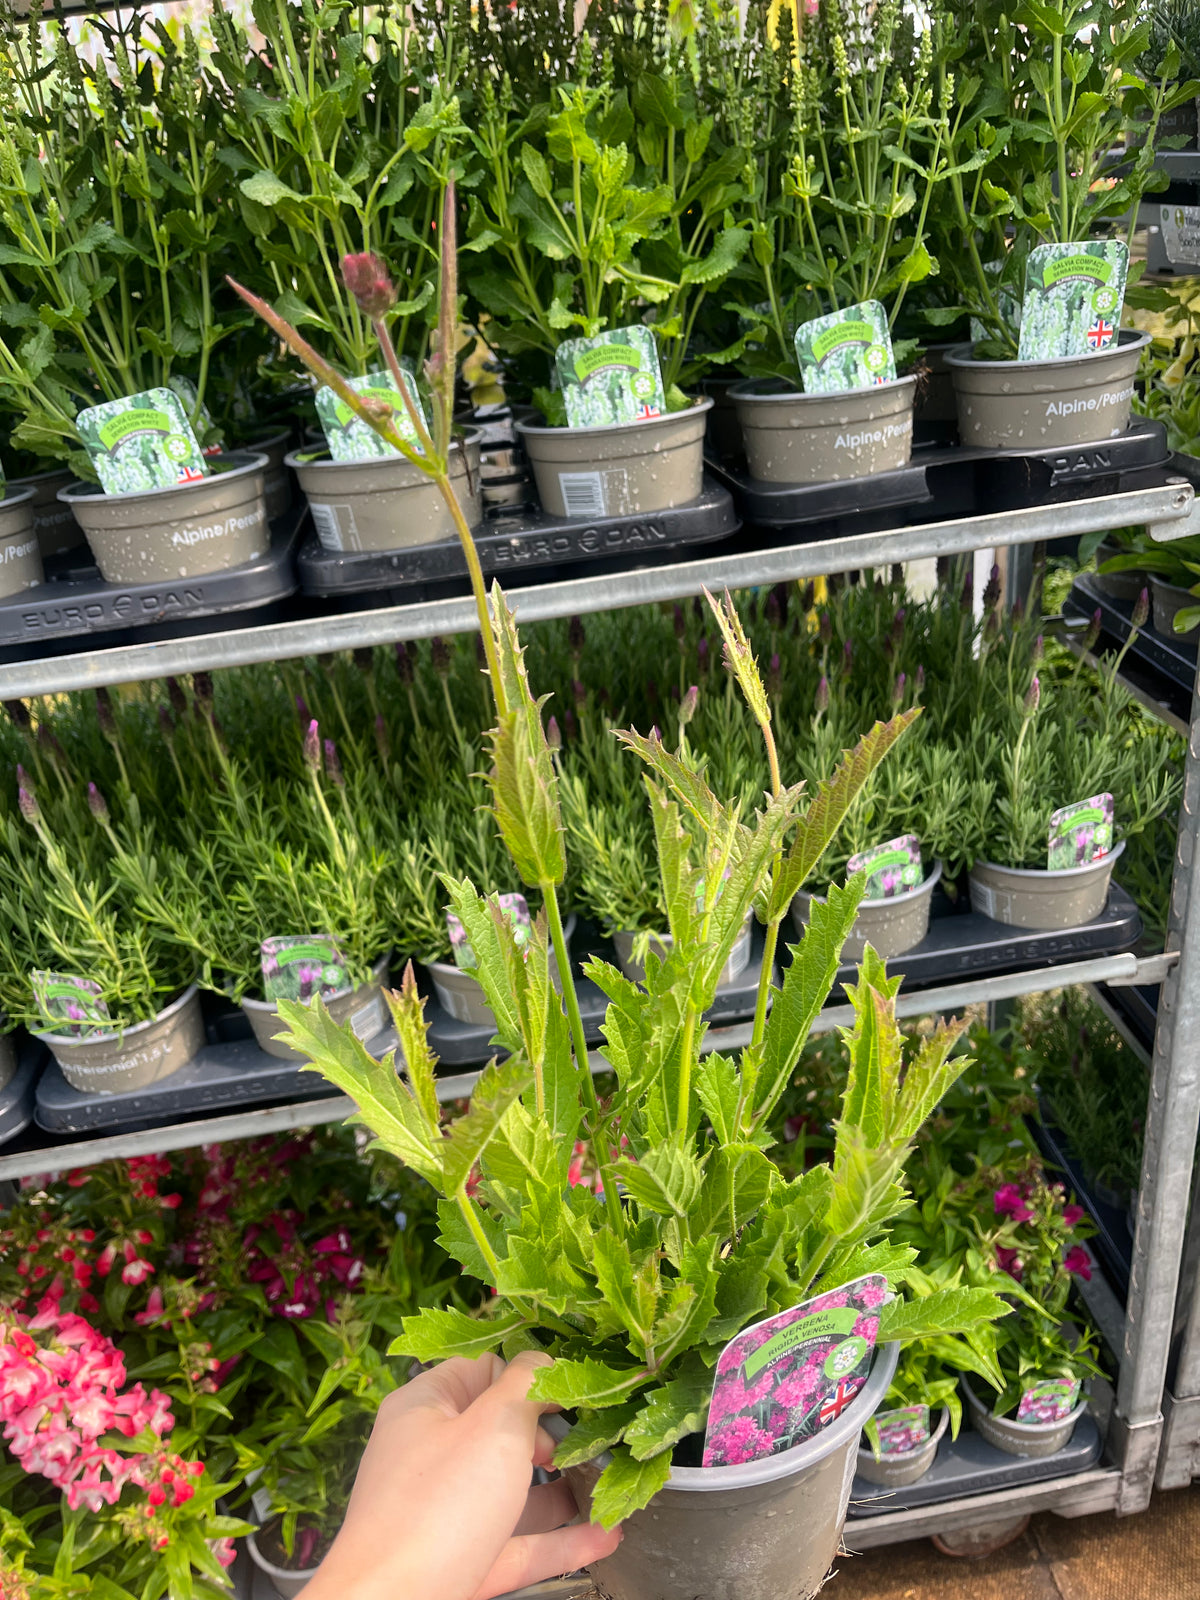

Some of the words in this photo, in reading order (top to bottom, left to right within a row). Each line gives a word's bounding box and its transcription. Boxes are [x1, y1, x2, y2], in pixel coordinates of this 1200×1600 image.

[1053, 259, 1074, 270] SALVIA
[1076, 258, 1105, 269] COMPACT
[1085, 266, 1102, 275] WHITE
[494, 538, 572, 562] EURO
[605, 521, 667, 546] DAN
[21, 602, 105, 631] EURO
[139, 587, 204, 613] DAN
[768, 1335, 800, 1358] RIGIDA
[801, 1322, 837, 1338] VENOSA
[782, 1314, 830, 1340] VERBENA
[766, 1335, 832, 1369] ALPINE/PERENNIAL
